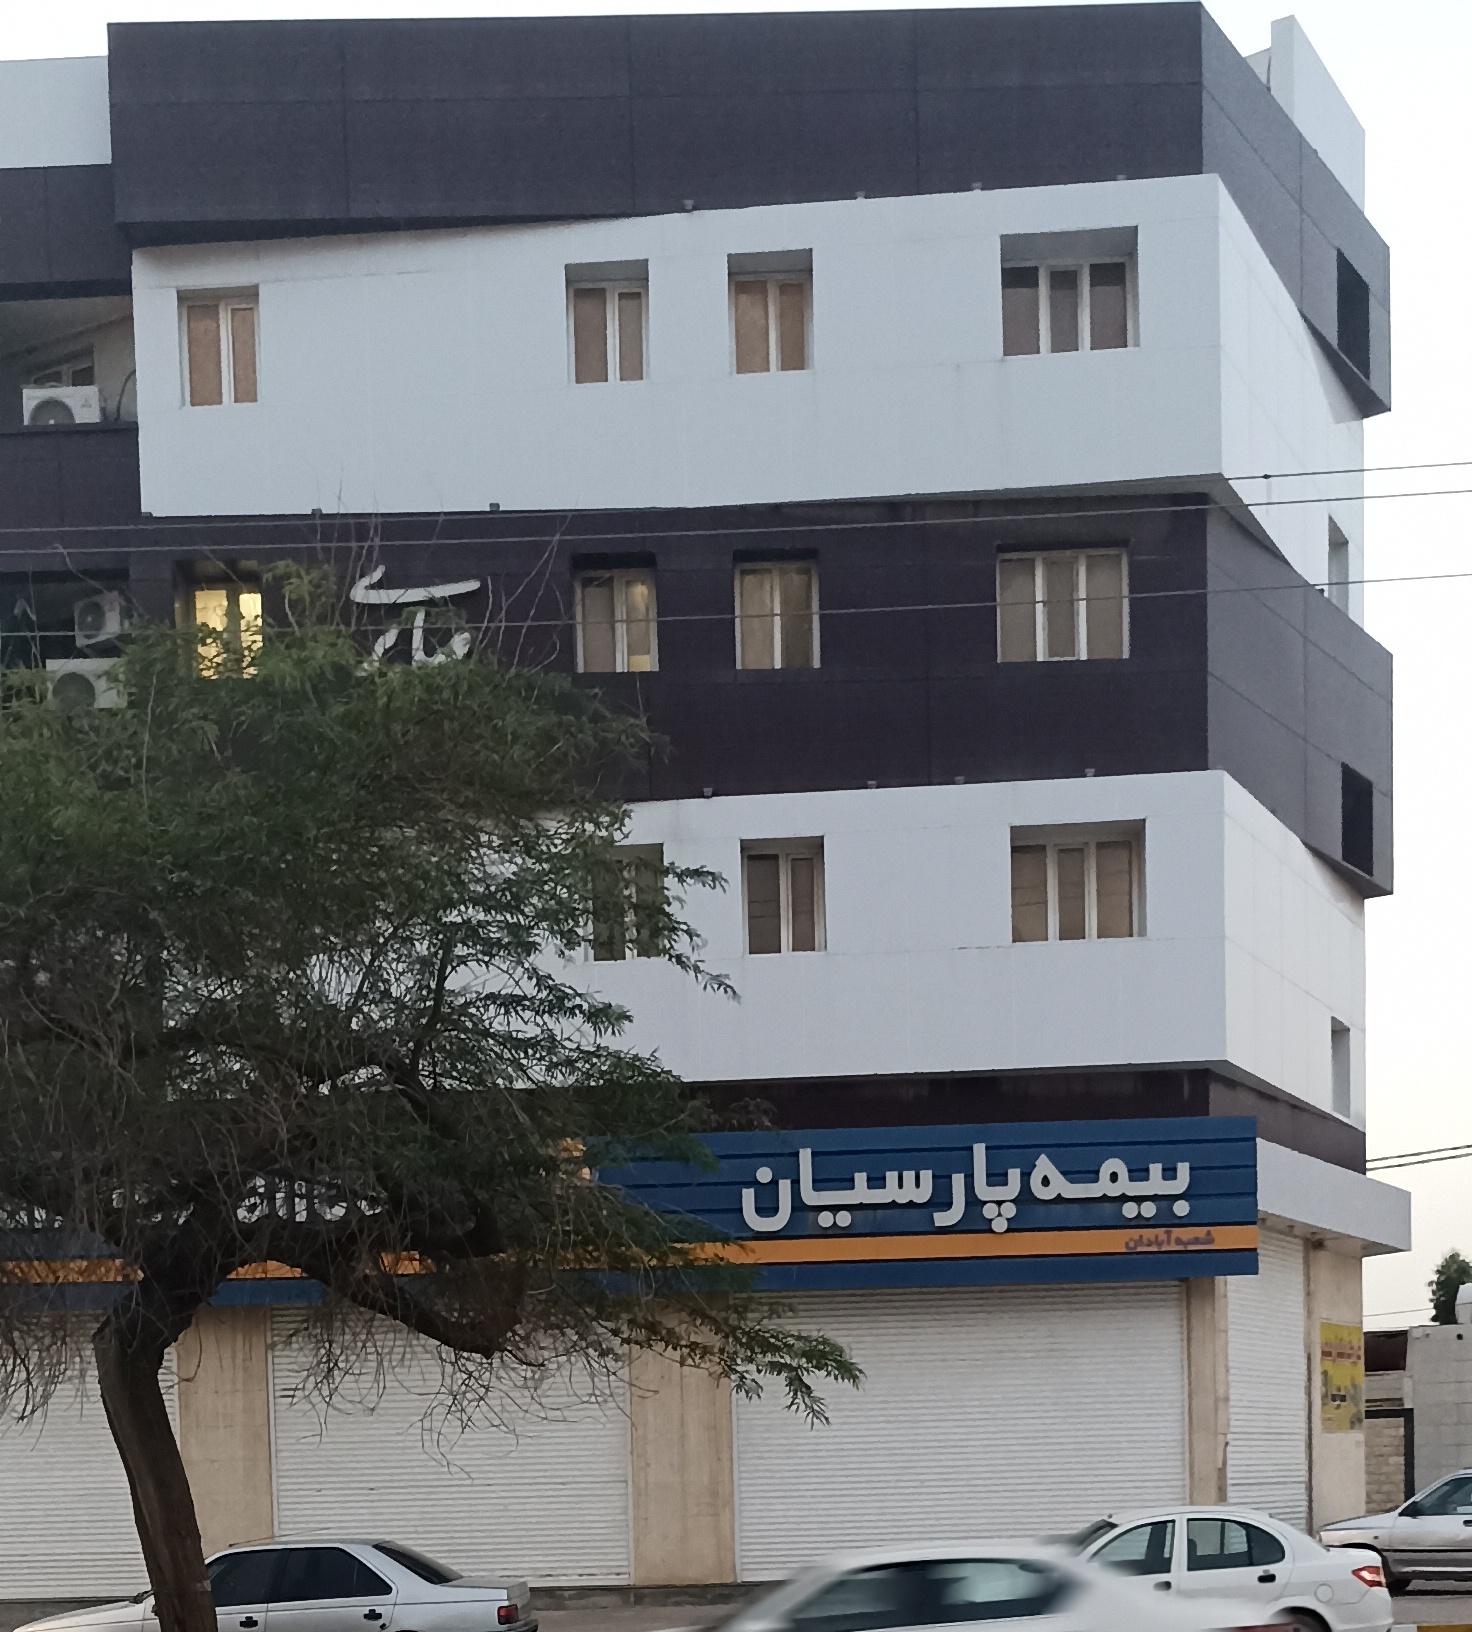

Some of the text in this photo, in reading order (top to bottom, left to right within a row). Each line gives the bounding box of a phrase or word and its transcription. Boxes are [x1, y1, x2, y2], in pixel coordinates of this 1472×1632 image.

[741, 1142, 1191, 1233] بیمه پارسیان
[1124, 1229, 1215, 1251] شعبه آبادان
